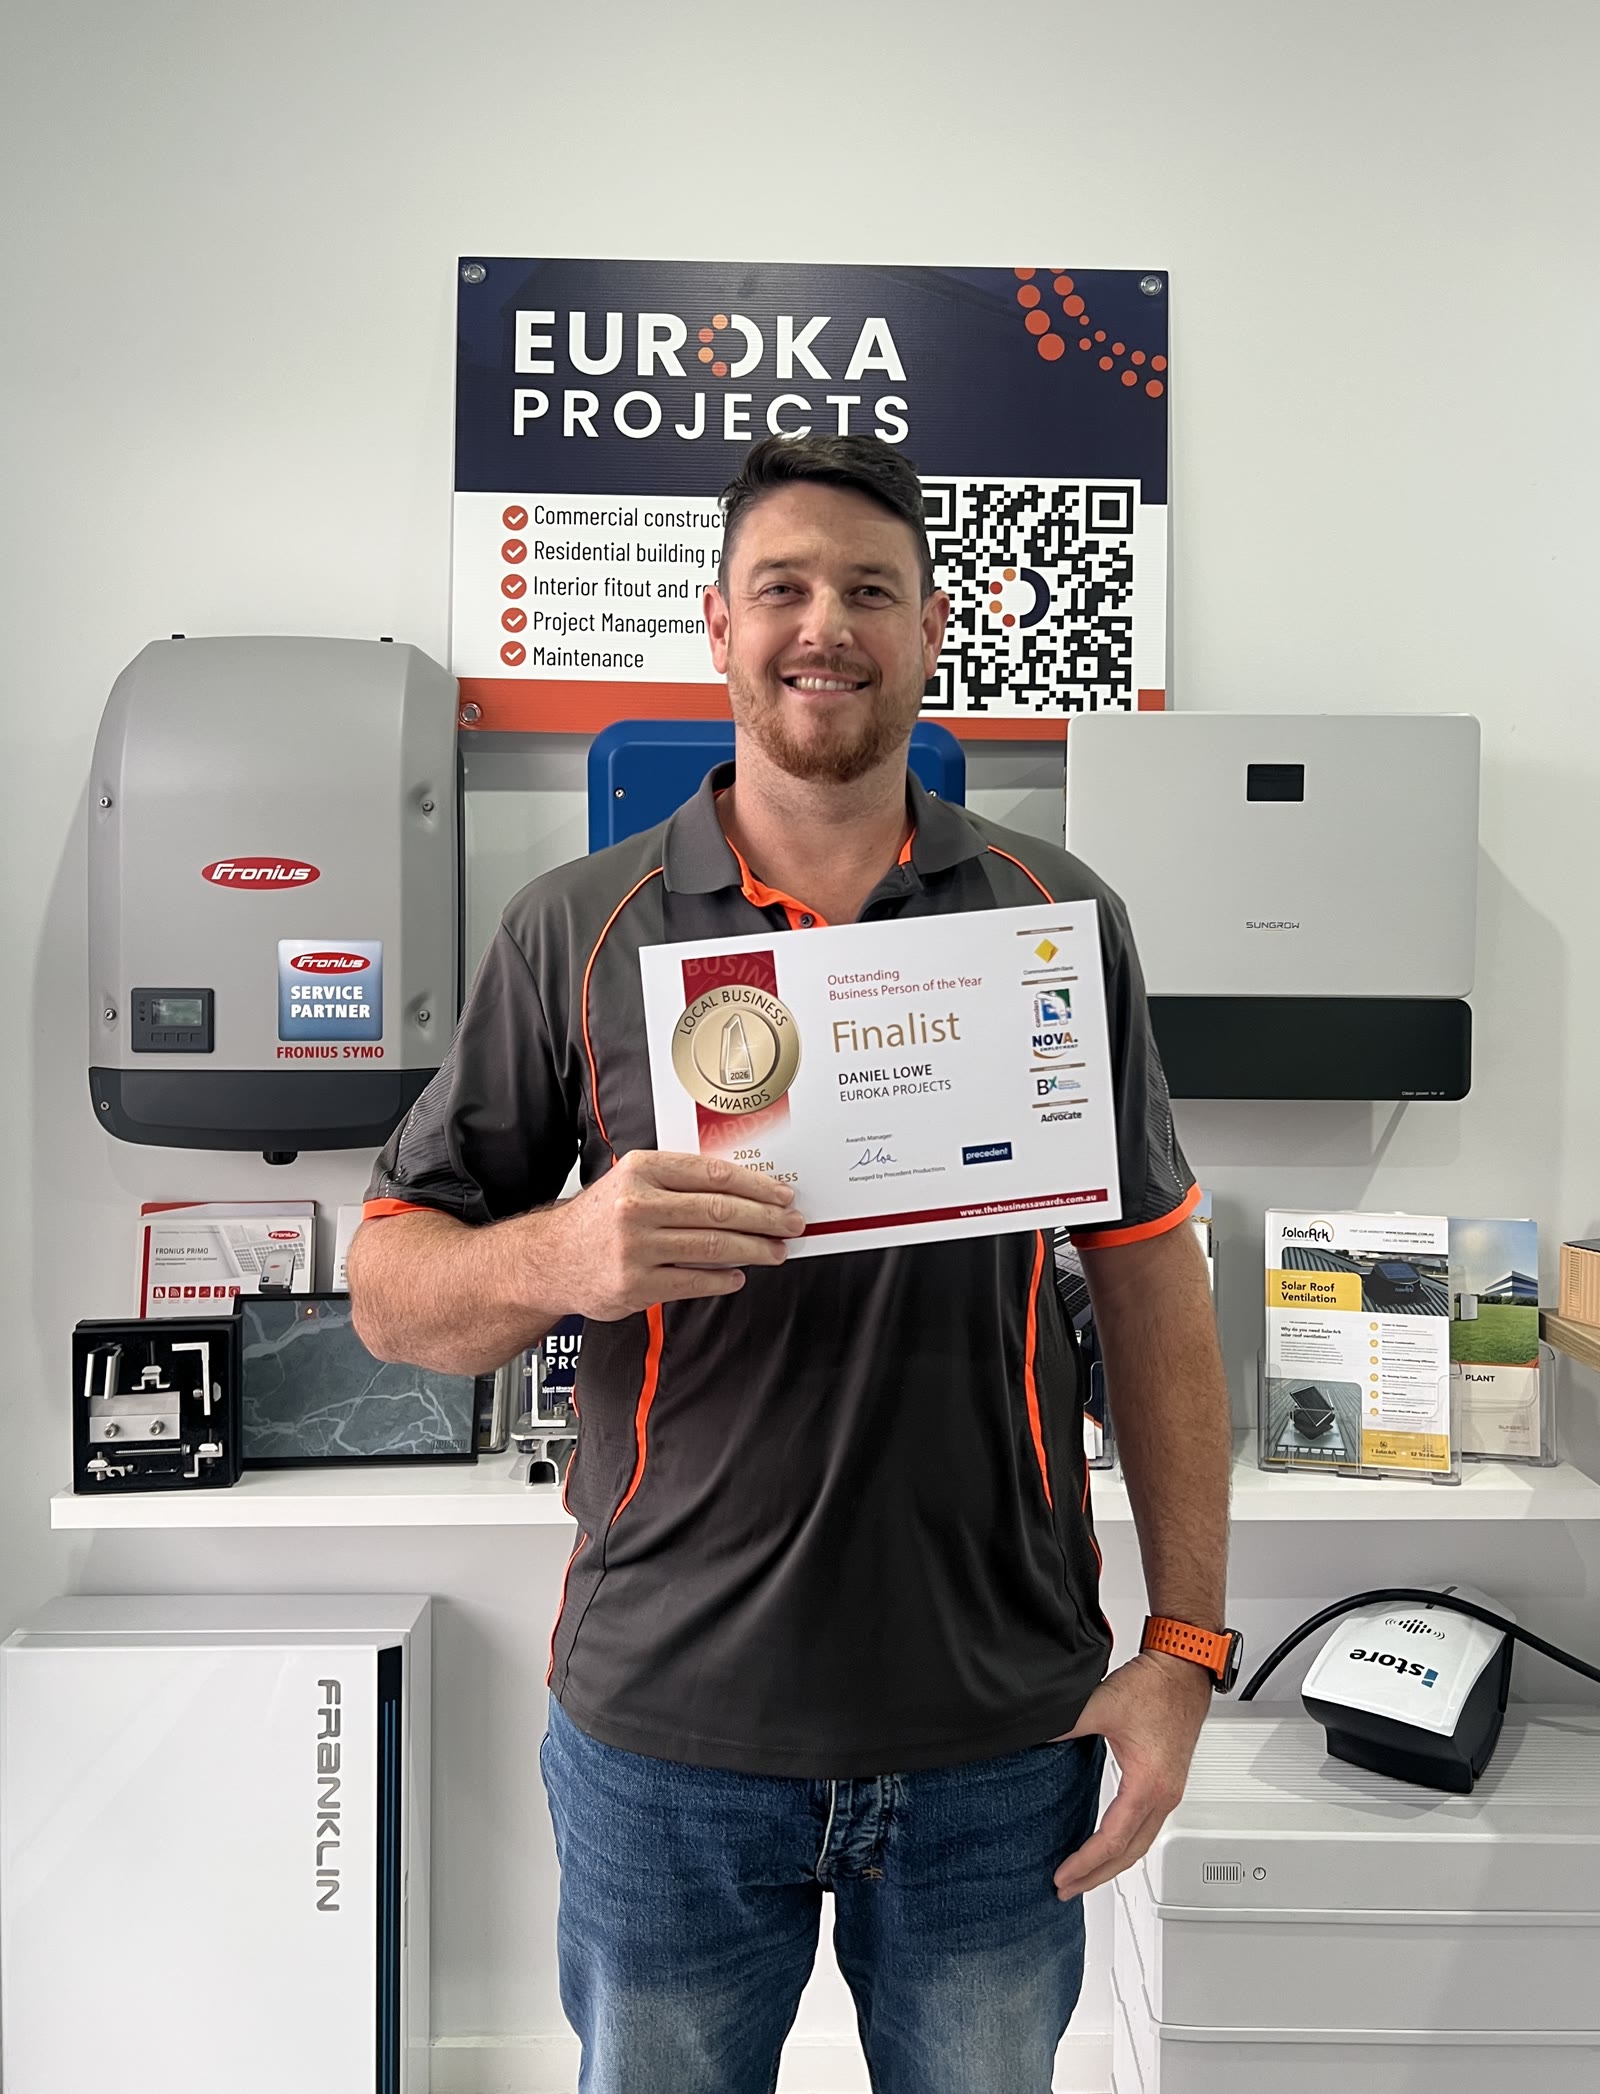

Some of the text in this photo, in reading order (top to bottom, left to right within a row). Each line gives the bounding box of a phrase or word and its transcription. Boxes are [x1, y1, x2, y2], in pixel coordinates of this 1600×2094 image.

[514, 310, 907, 382] EUROKA
[512, 388, 909, 444] PROJECTS
[534, 505, 638, 527] Commercial
[534, 541, 630, 562] Residential
[637, 543, 705, 568] building
[534, 576, 598, 596] Interior
[604, 577, 651, 597] fitout
[657, 579, 688, 598] and
[533, 611, 595, 636] Project
[533, 646, 644, 668] Maintenance
[211, 863, 311, 880] Fronius
[1245, 921, 1300, 929] SUNGROW
[296, 955, 365, 968] Fronius
[827, 969, 900, 986] Outstanding
[290, 985, 363, 1000] SERVICE
[829, 976, 982, 1001] Business Person of the Year
[291, 1004, 371, 1018] PARTNER
[680, 989, 788, 1035] LOCAL BUSINESS
[832, 1012, 961, 1053] Finalist
[276, 1046, 384, 1059] FRONIUS SYMO
[730, 1070, 750, 1081] 2026
[838, 1064, 933, 1085] DANIEL LOWE
[840, 1079, 952, 1102] EUROKA PROJECTS
[708, 1089, 771, 1110] AWARDS
[1040, 1111, 1082, 1123] Advocate
[845, 1135, 866, 1143] Awards
[733, 1149, 761, 1160] 2026
[965, 1147, 1008, 1160] precedent
[848, 1174, 875, 1182] Managed
[884, 1169, 912, 1178] Precedent
[912, 1166, 946, 1175] Productions
[960, 1194, 1097, 1217] www.thebusinessawards.com.au
[1281, 1226, 1331, 1243] SolarArk
[155, 1247, 209, 1255] FRONIUS PRIMO
[1281, 1280, 1335, 1292] Solar Roof
[1281, 1292, 1337, 1303] Ventilation
[1465, 1374, 1496, 1382] PLANT
